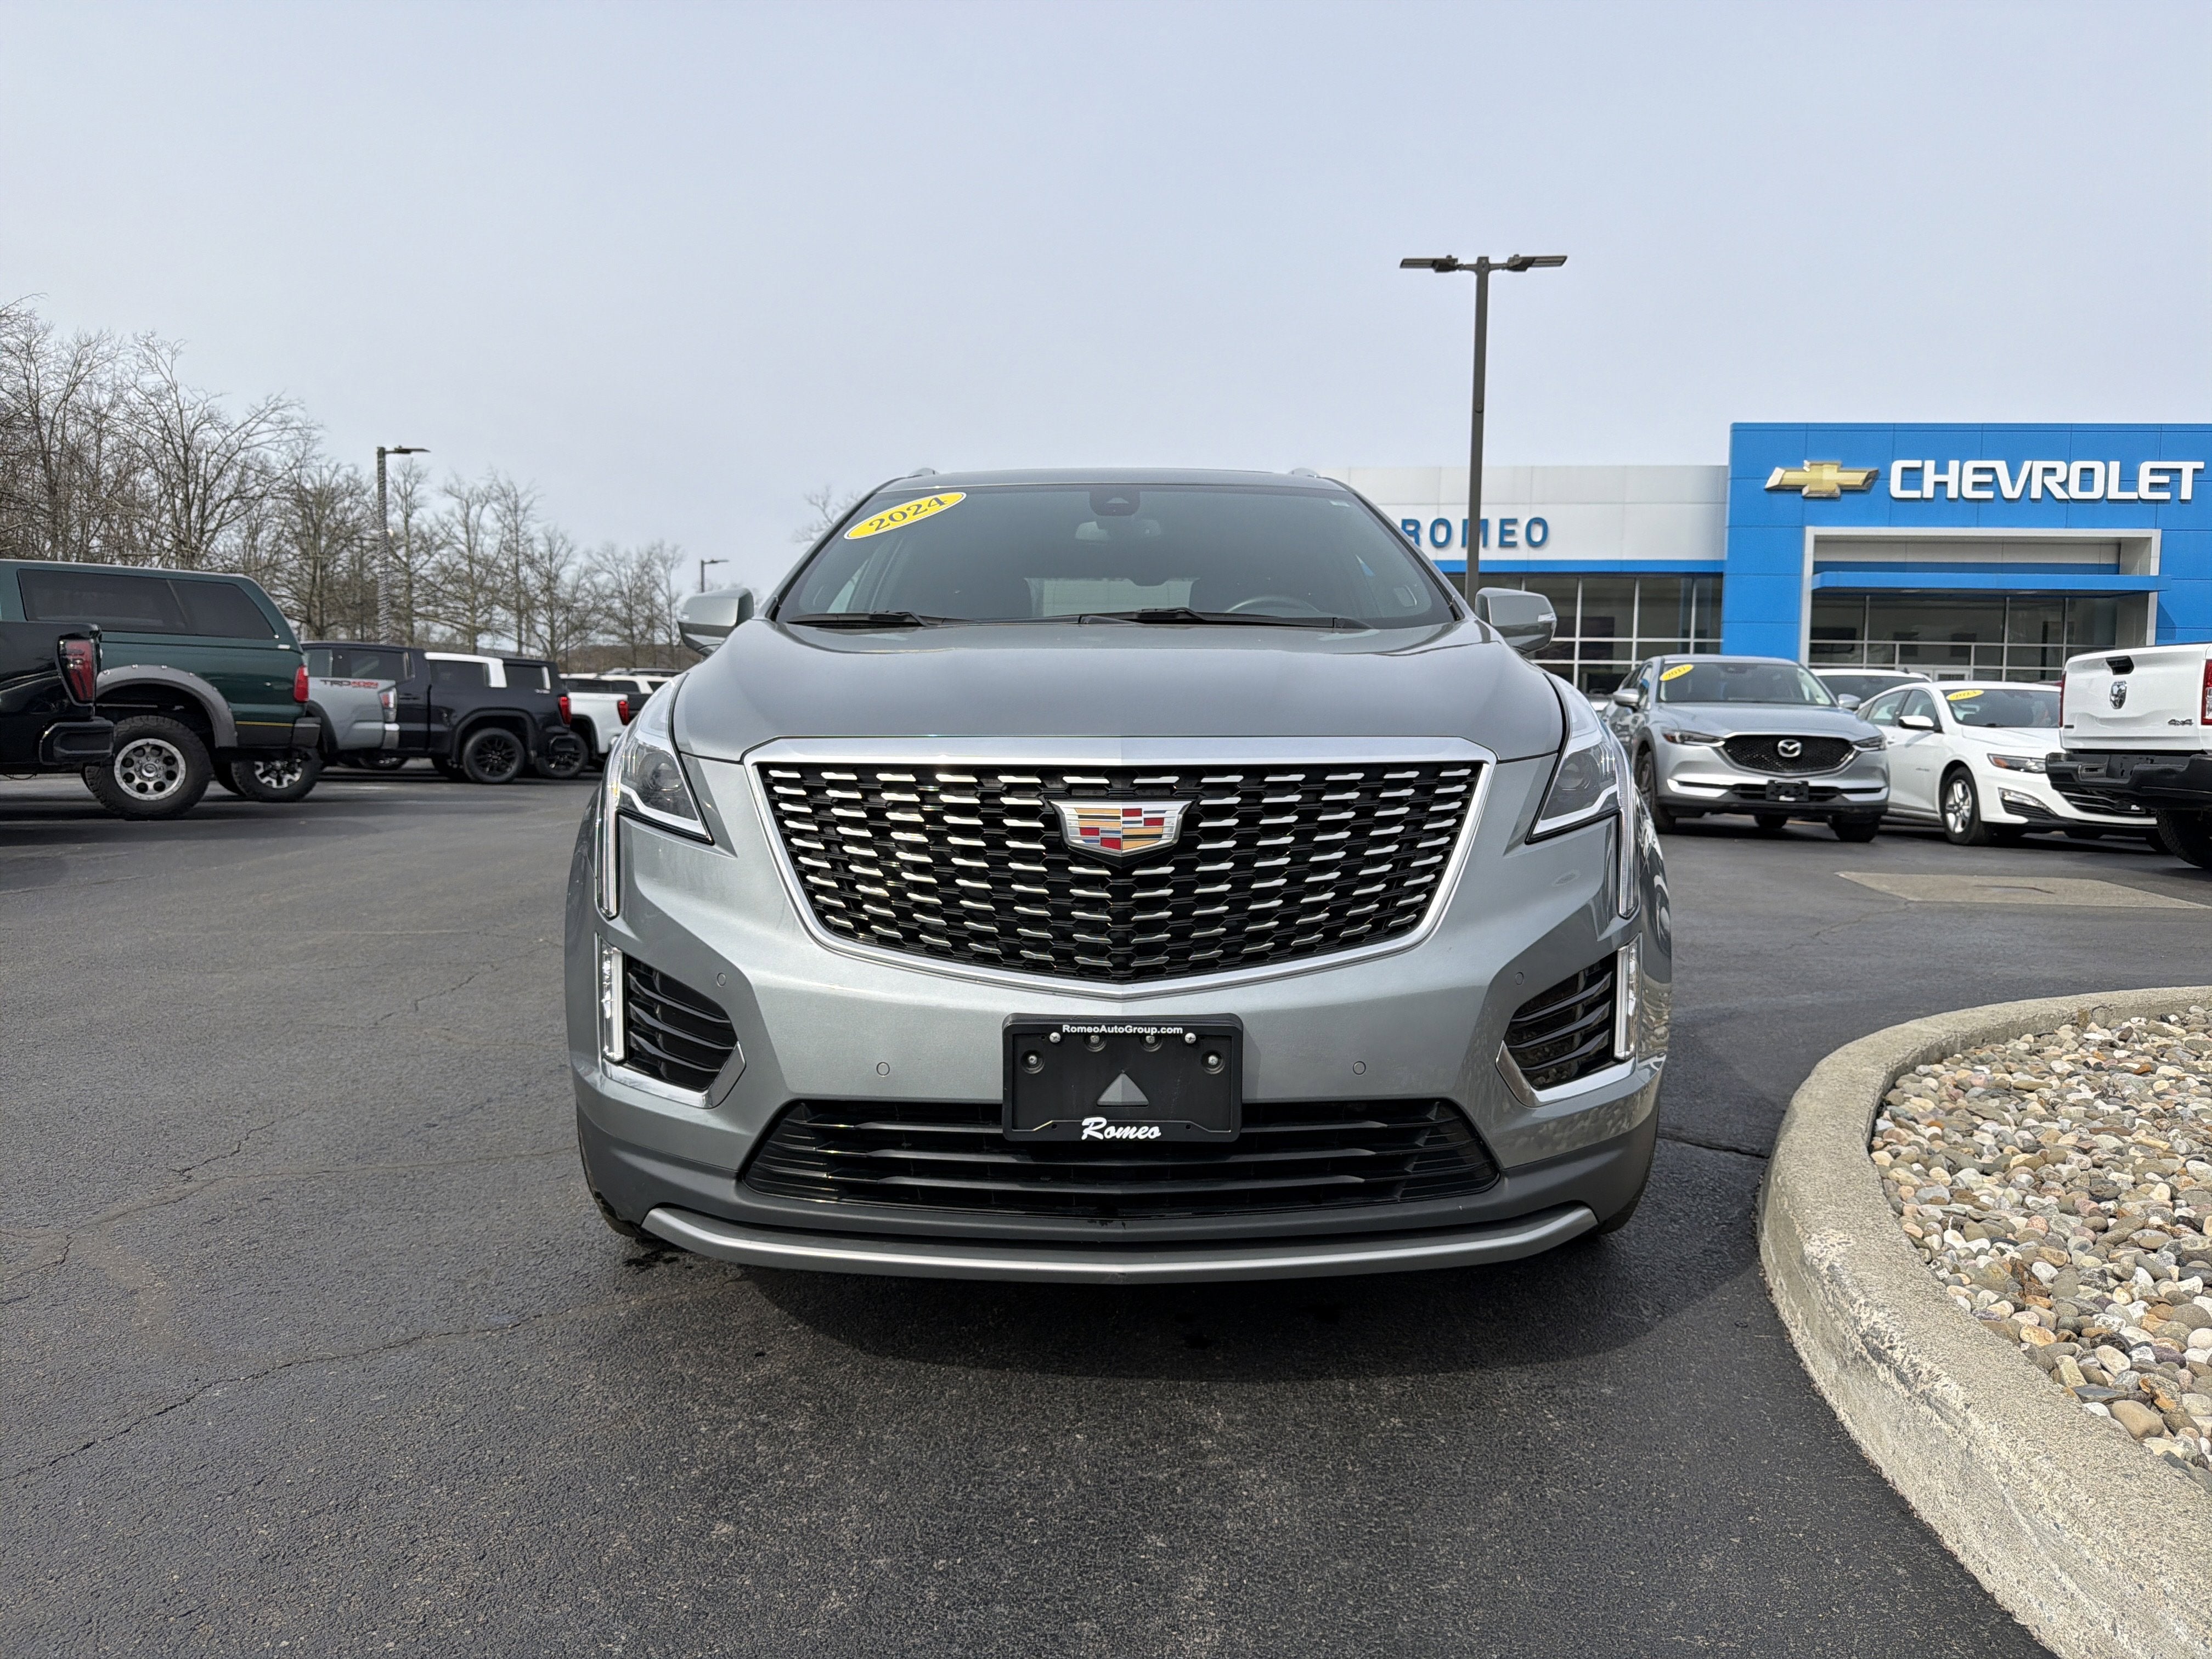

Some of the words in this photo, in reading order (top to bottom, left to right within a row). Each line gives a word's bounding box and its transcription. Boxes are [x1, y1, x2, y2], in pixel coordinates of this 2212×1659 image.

[1889, 460, 2205, 500] CHEVROLET
[868, 496, 947, 532] 2024
[1062, 1024, 1183, 1035] RomeoAutoGroup.com
[1081, 1116, 1161, 1140] Romeo
